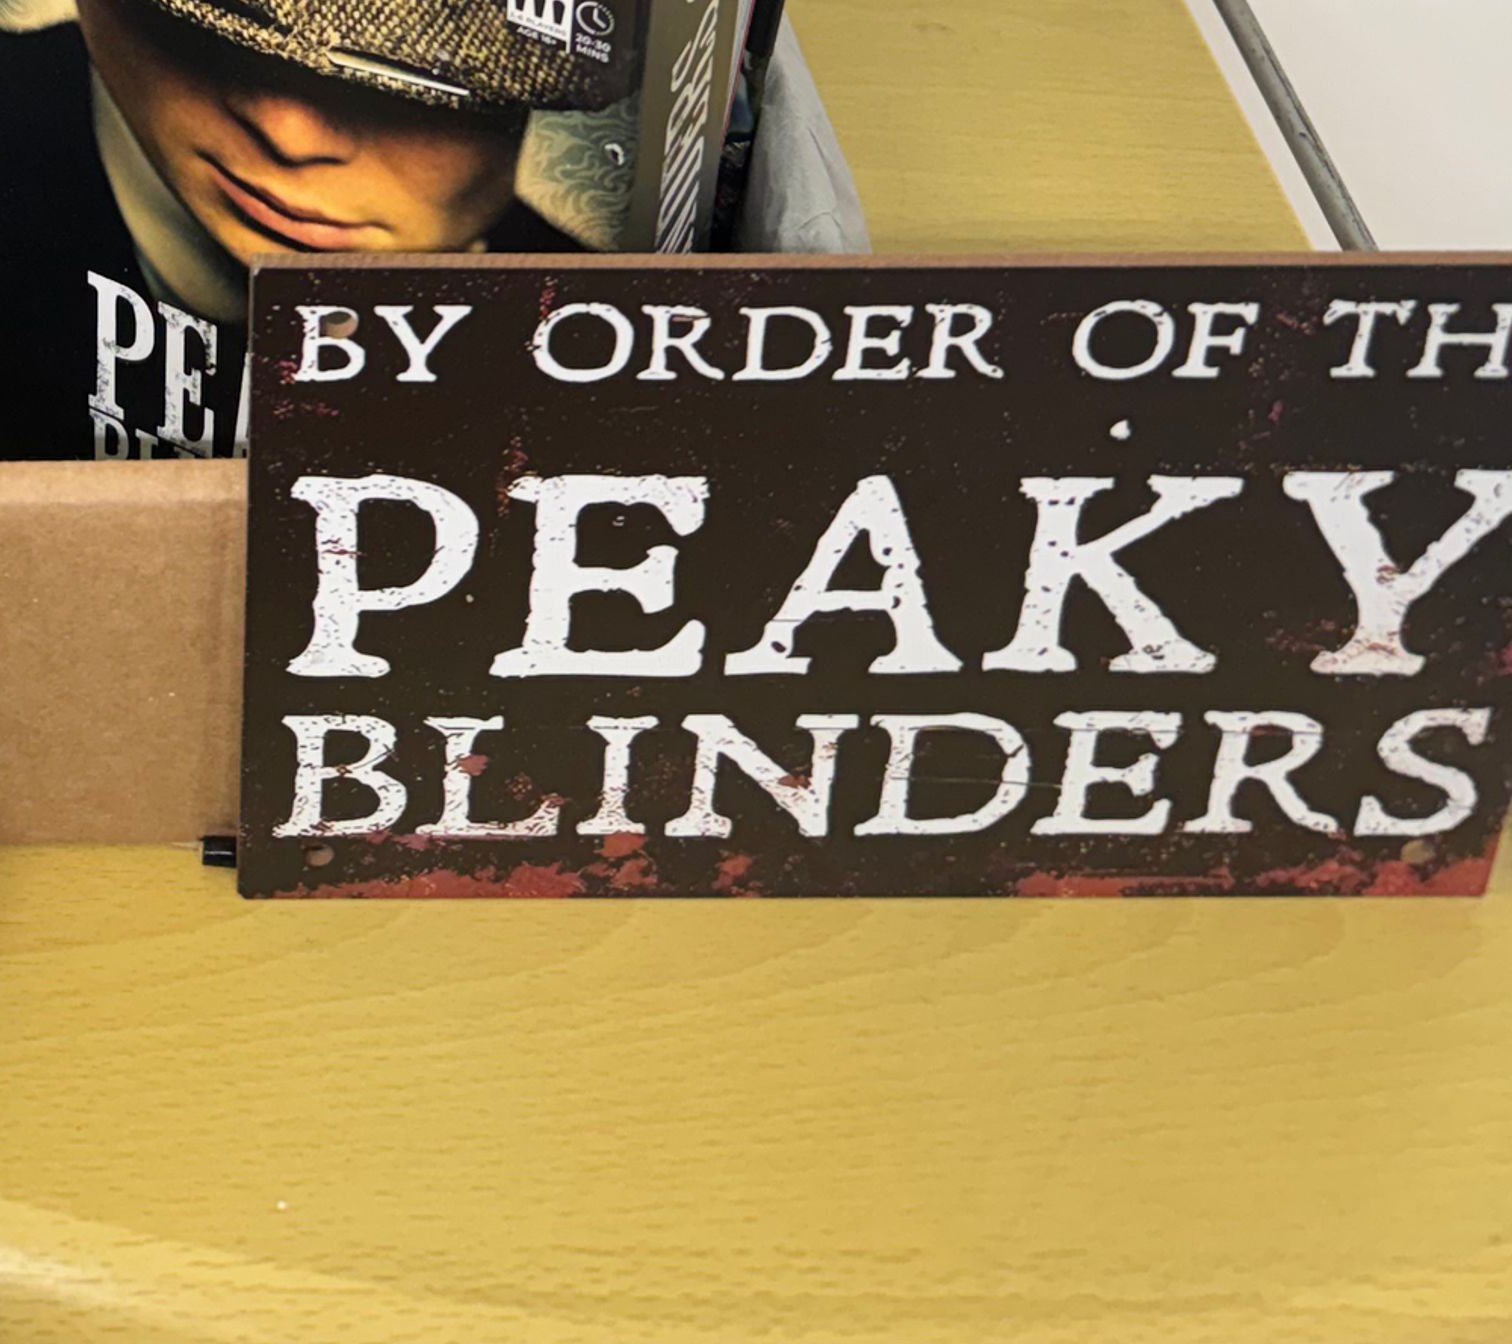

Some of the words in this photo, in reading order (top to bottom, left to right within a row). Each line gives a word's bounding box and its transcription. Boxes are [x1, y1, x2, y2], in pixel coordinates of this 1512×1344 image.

[575, 32, 611, 53] 20-30
[575, 44, 609, 64] MINS
[293, 304, 473, 385] BY
[530, 301, 1006, 383] ORDER
[1070, 299, 1260, 381] OF
[1322, 298, 1512, 381] TH
[285, 468, 1512, 680] PEAKY
[271, 705, 1493, 840] BLINDERS
